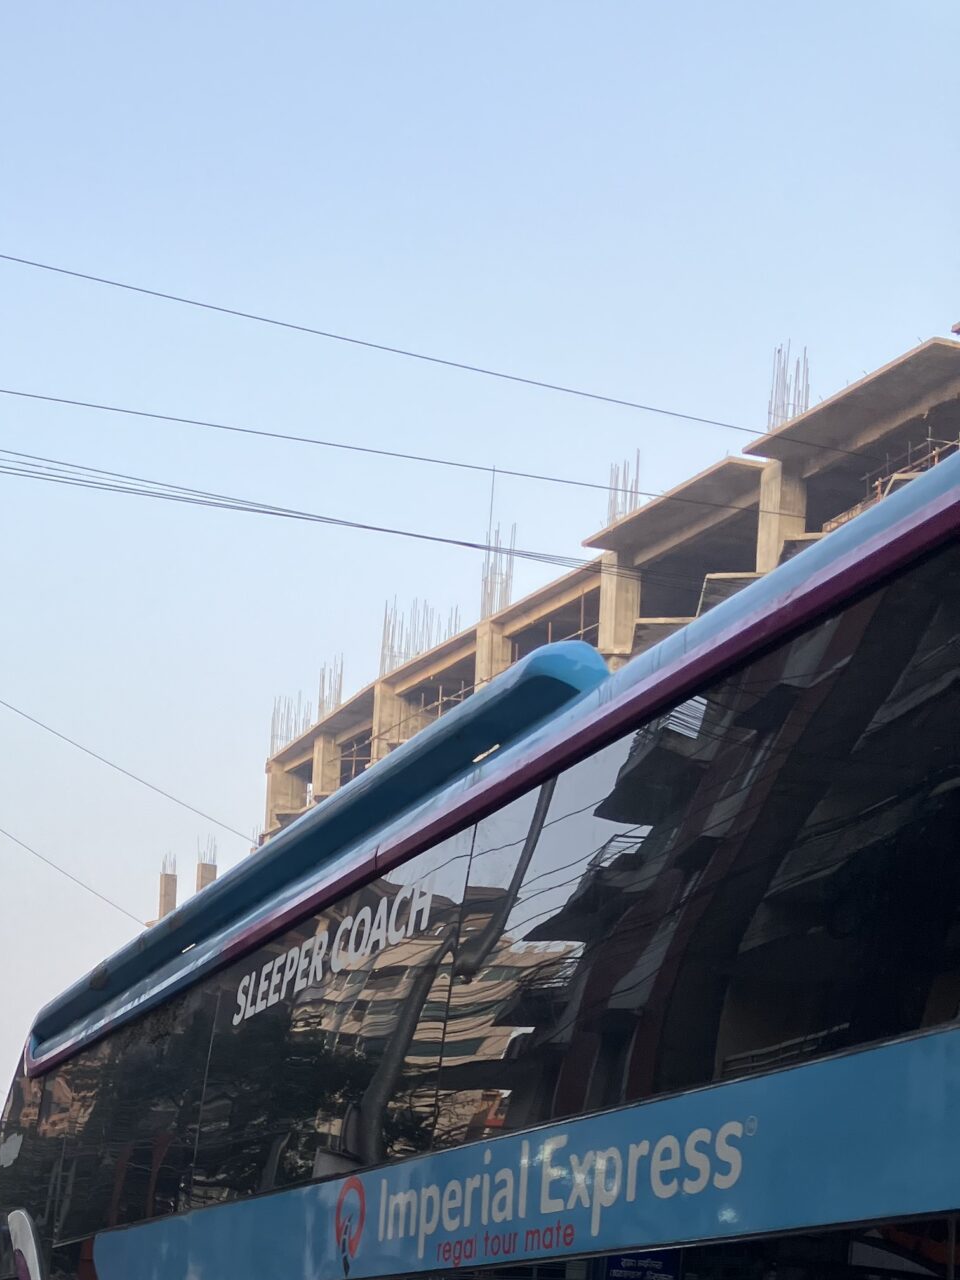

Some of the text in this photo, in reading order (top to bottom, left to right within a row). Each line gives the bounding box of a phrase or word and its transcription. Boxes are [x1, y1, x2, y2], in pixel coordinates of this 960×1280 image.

[232, 877, 433, 1026] SLEEPER COACH
[378, 1120, 744, 1259] Imperial Express
[436, 1220, 575, 1268] regal tour mate
